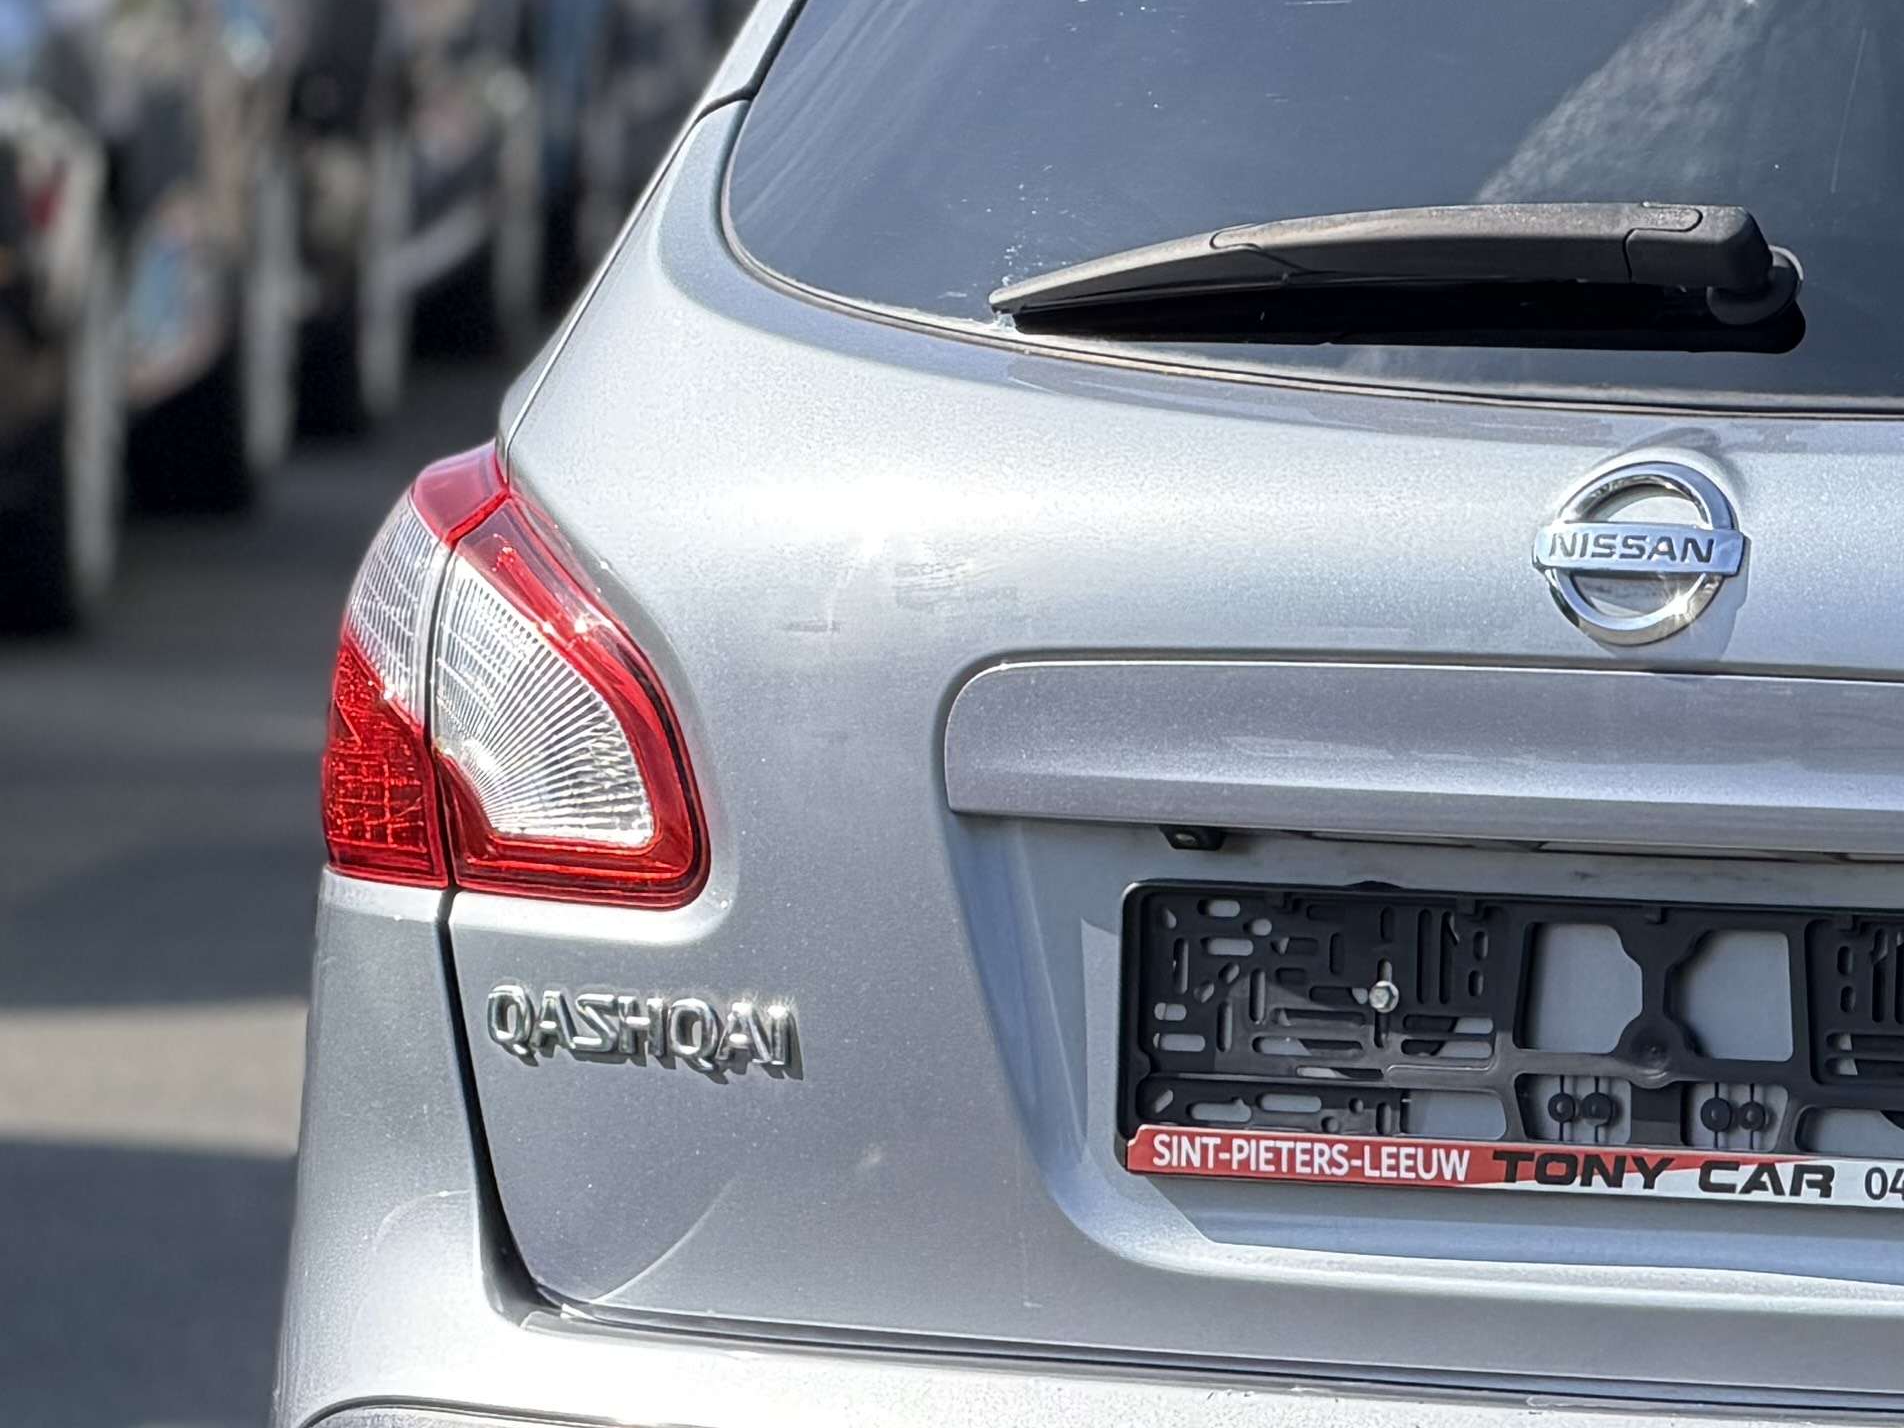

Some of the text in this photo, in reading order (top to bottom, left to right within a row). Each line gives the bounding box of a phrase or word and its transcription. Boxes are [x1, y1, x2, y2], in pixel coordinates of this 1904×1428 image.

[1549, 531, 1715, 563] NISSAN
[488, 985, 800, 1071] QASHQAI
[1152, 1133, 1472, 1183] SINT-PIETERS-LEEUW
[1493, 1150, 1678, 1190] TONY
[1698, 1160, 1837, 1200] CAR
